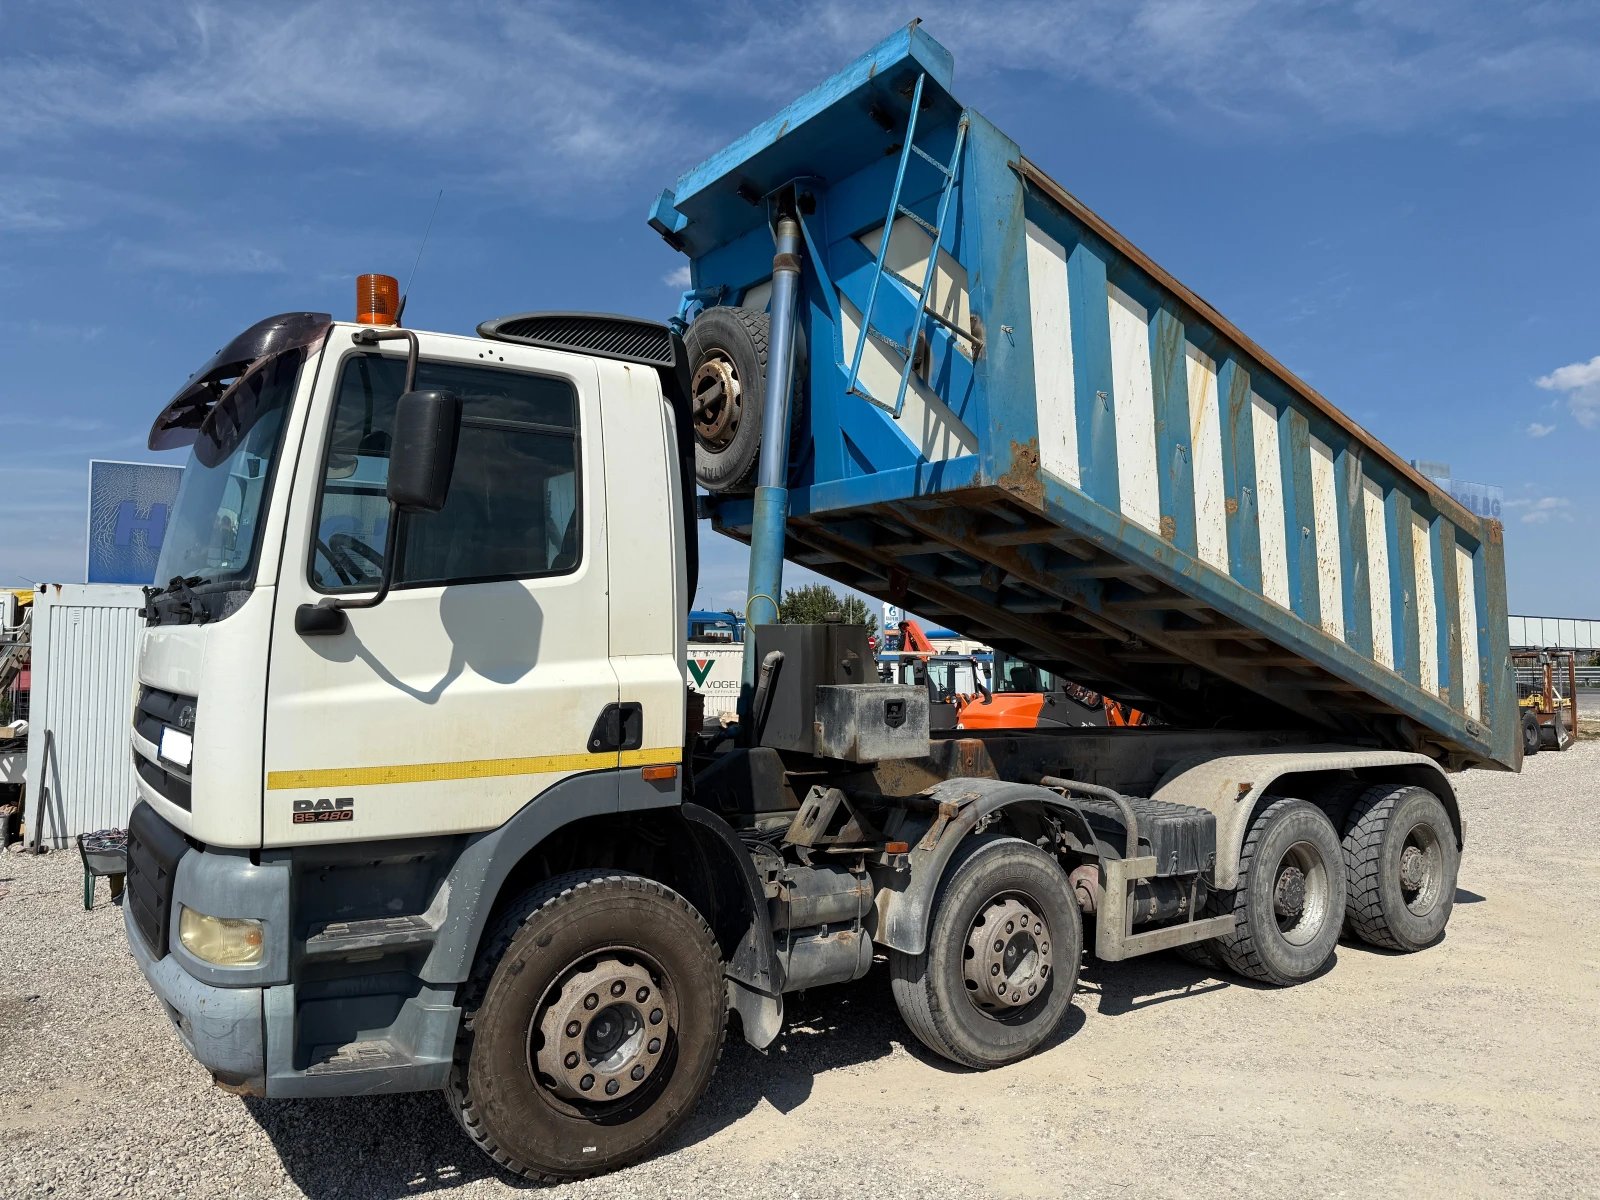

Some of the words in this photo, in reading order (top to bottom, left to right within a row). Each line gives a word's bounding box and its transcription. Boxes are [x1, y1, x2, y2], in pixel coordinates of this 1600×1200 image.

[705, 680, 742, 689] VOGEL
[293, 798, 353, 811] DAF
[294, 811, 352, 822] 85.480
